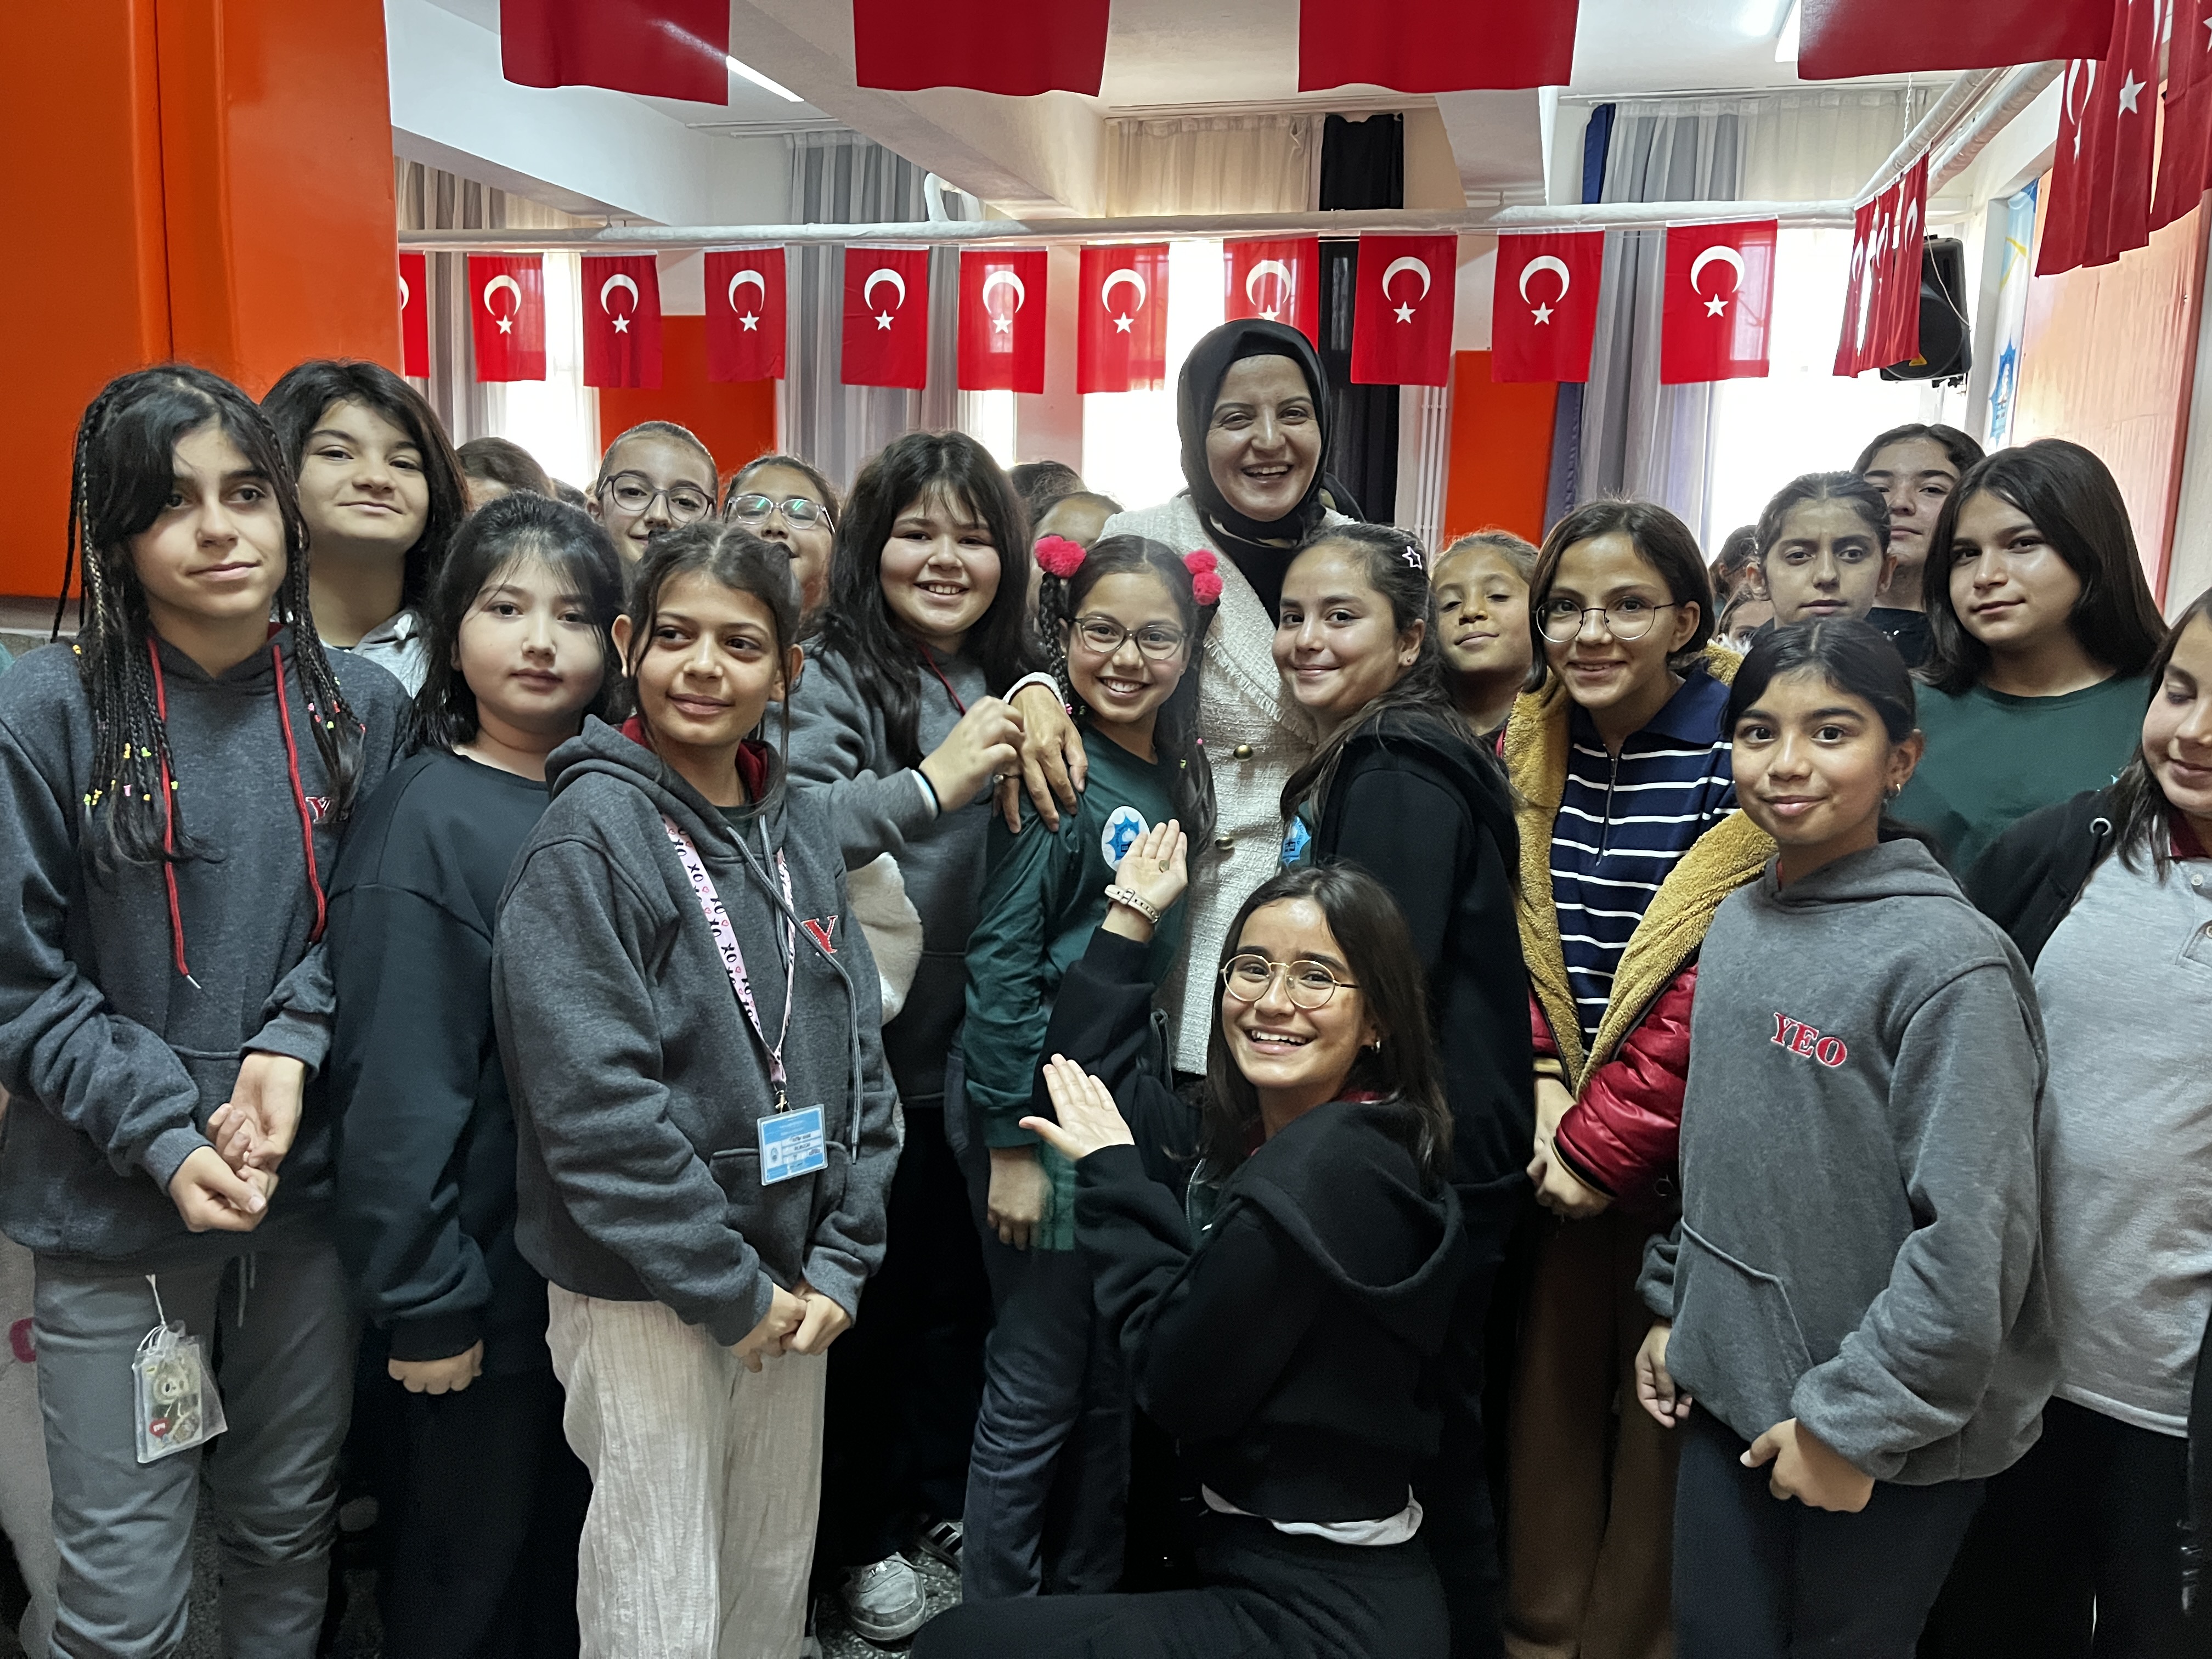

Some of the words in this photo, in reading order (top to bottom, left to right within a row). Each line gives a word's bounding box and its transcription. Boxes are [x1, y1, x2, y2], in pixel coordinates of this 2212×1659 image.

[687, 863, 704, 882] XO
[720, 943, 737, 963] XO
[1770, 1012, 1848, 1068] YEO
